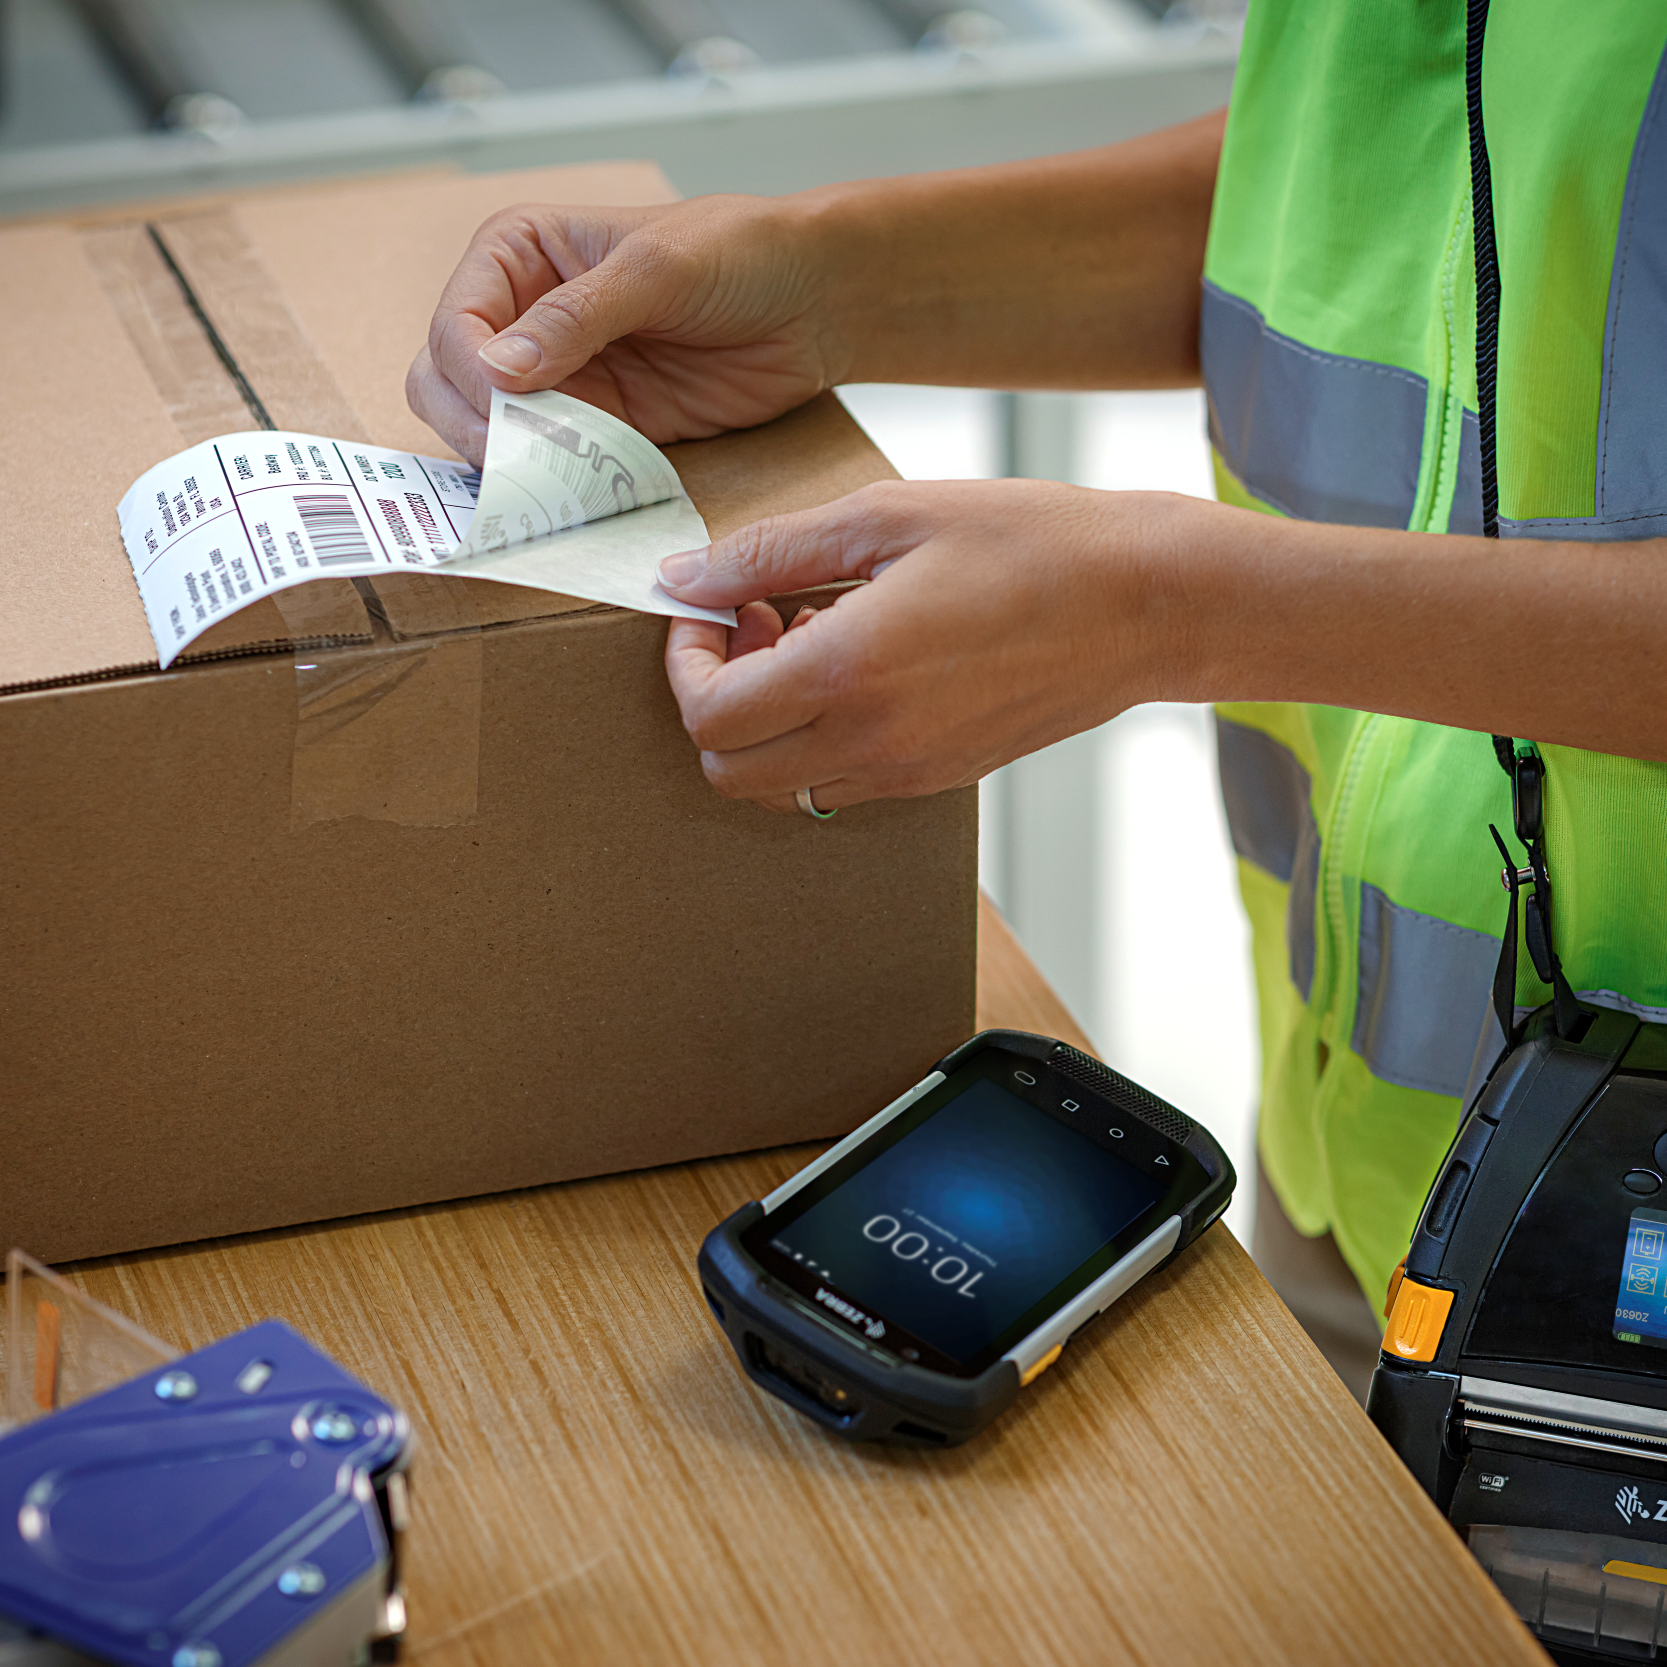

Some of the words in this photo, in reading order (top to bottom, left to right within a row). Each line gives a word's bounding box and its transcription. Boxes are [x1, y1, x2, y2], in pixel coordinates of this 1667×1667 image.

[233, 454, 254, 480] CARRIER:
[264, 454, 281, 474] Bestway
[156, 490, 168, 510] Center
[176, 499, 187, 515] Main
[209, 496, 222, 511] USA
[162, 506, 178, 537] Distribution
[179, 511, 191, 526] 1234
[147, 539, 159, 554] SHIP
[862, 1214, 984, 1299] 10:00
[815, 1287, 866, 1325] ZEBRA
[1615, 1307, 1650, 1322] ZQ630
